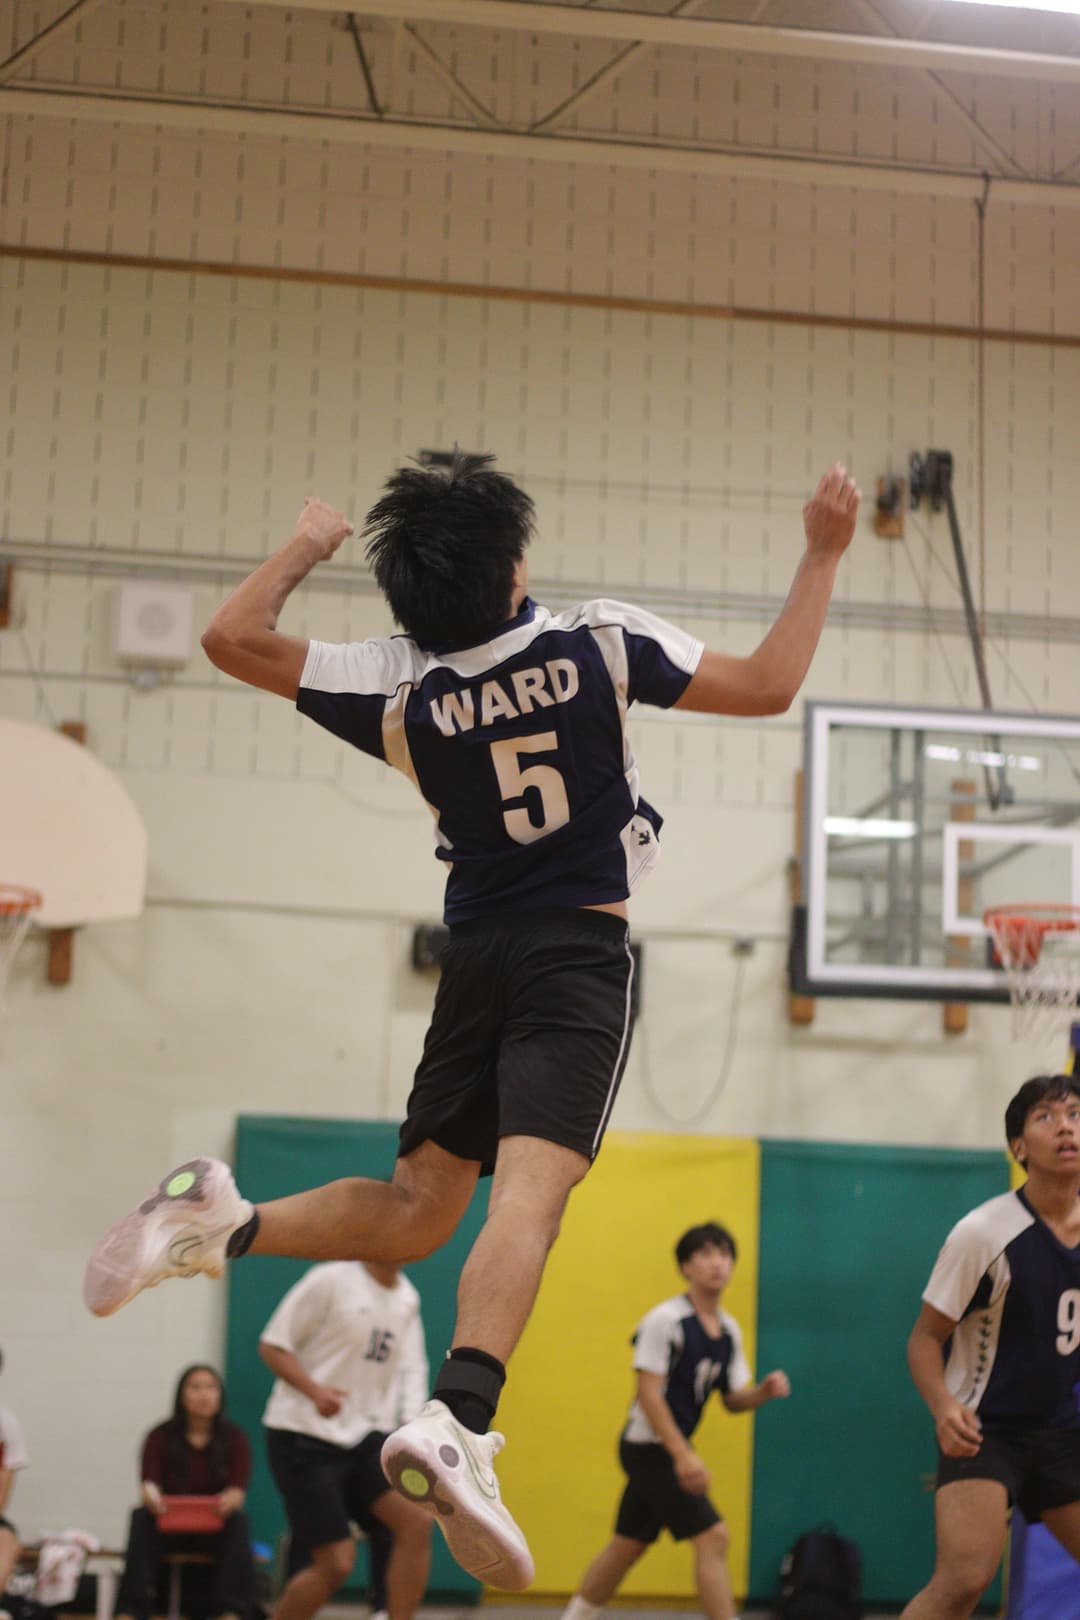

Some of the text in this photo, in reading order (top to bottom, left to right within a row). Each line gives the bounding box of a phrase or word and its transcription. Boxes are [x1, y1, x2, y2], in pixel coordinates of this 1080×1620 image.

[430, 658, 580, 737] WARD
[490, 730, 571, 846] 5
[1056, 1288, 1080, 1356] 9
